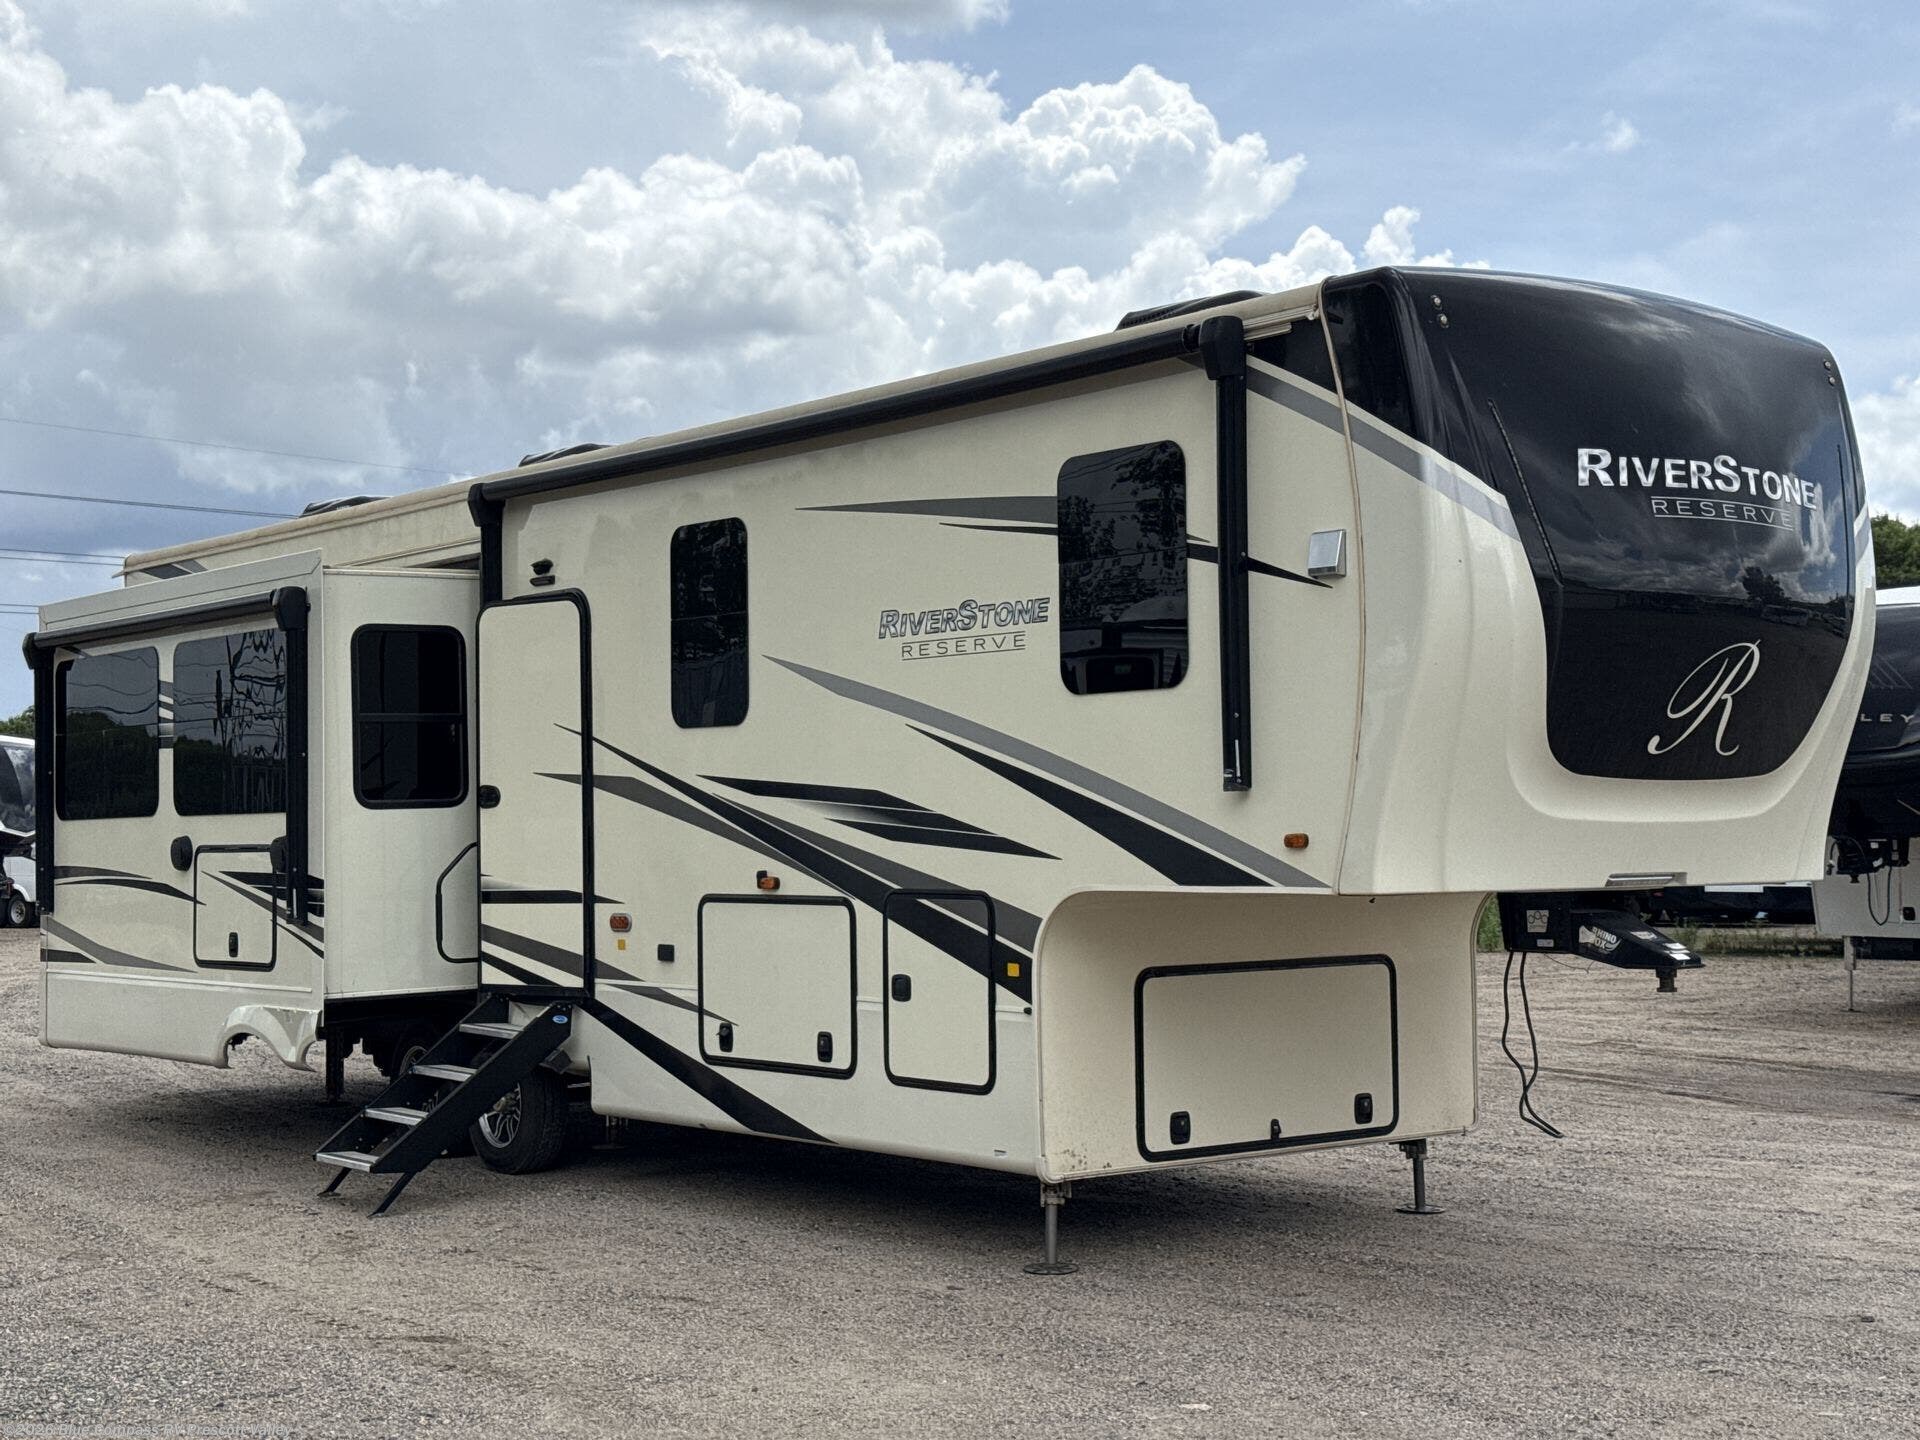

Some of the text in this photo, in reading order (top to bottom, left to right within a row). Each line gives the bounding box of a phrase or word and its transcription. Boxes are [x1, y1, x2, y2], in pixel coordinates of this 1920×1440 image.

[1577, 448, 1817, 509] RIVERSTONE
[1651, 499, 1793, 528] RESERVE
[878, 597, 1051, 639] RIVERSTONE
[901, 634, 1026, 658] RESERVE
